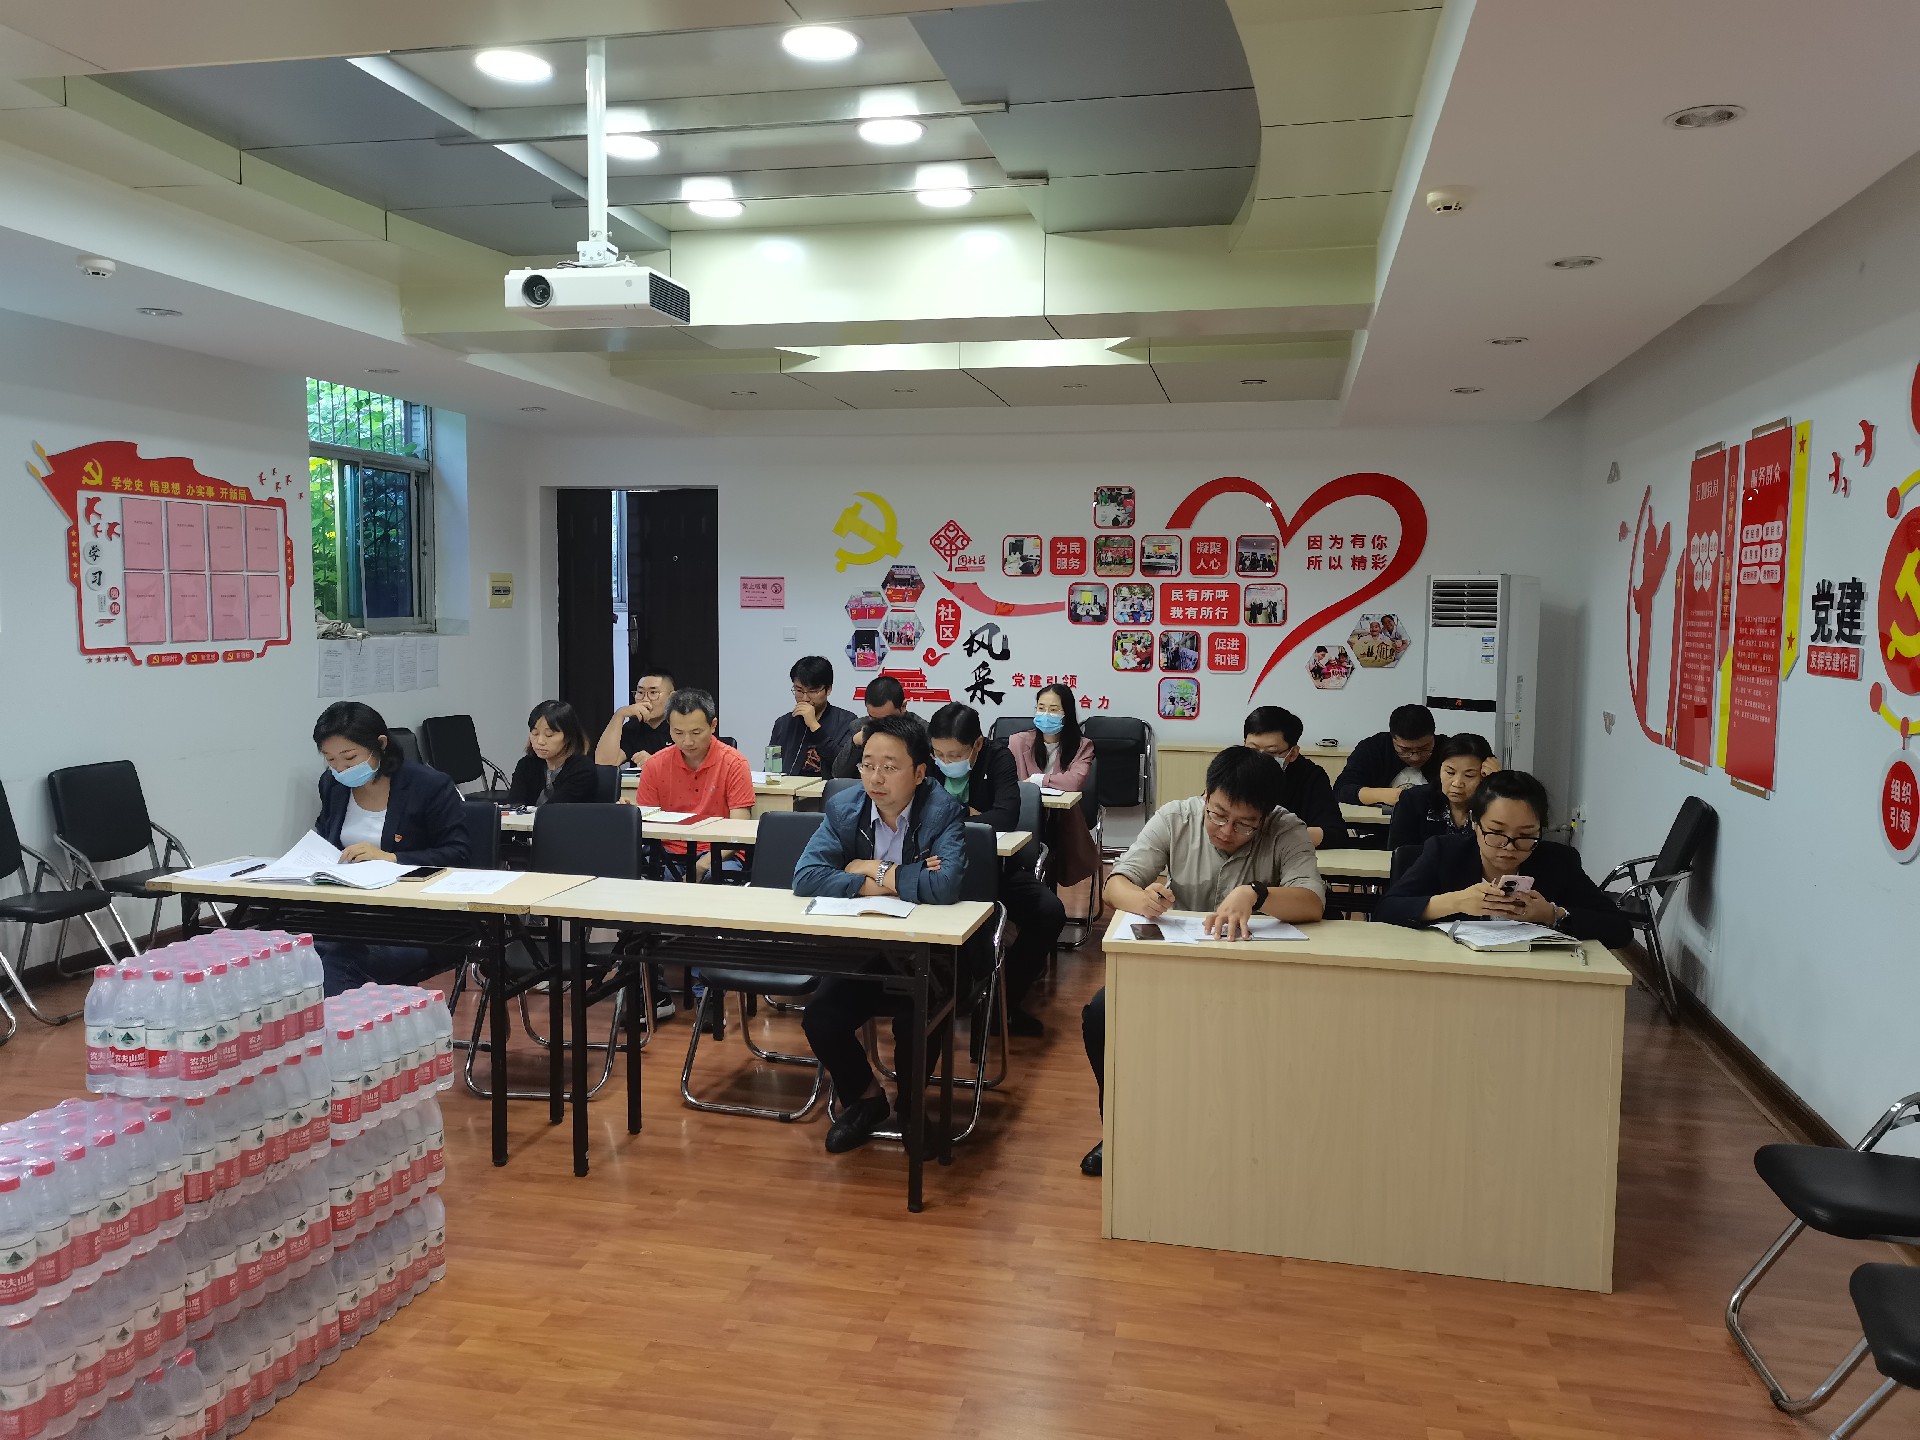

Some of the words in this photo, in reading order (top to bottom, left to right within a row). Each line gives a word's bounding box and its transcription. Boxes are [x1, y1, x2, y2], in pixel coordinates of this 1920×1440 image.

[1750, 462, 1781, 488] 服务群众
[111, 476, 144, 491] 学党史
[150, 479, 181, 495] 悟思想
[186, 484, 215, 498] 办实事
[220, 487, 247, 501] 开新局
[1056, 541, 1081, 555] 为民
[1196, 542, 1222, 555] 凝聚
[1307, 534, 1389, 550] 因为有你
[1056, 557, 1081, 570] 服务
[1196, 560, 1221, 570] 人心
[1306, 555, 1389, 571] 所以精彩
[1170, 589, 1230, 601] 民有所呼
[1169, 607, 1229, 620] 我有所行
[1810, 576, 1865, 645] 党建
[938, 604, 956, 641] 社区
[1214, 638, 1240, 651] 促进
[962, 622, 1011, 705] 风采
[1214, 654, 1240, 667] 和谐
[1809, 650, 1857, 673] 发挥党建作用
[1012, 672, 1077, 689] 党建引领
[1890, 778, 1912, 805] 组织
[1890, 806, 1911, 833] 引领
